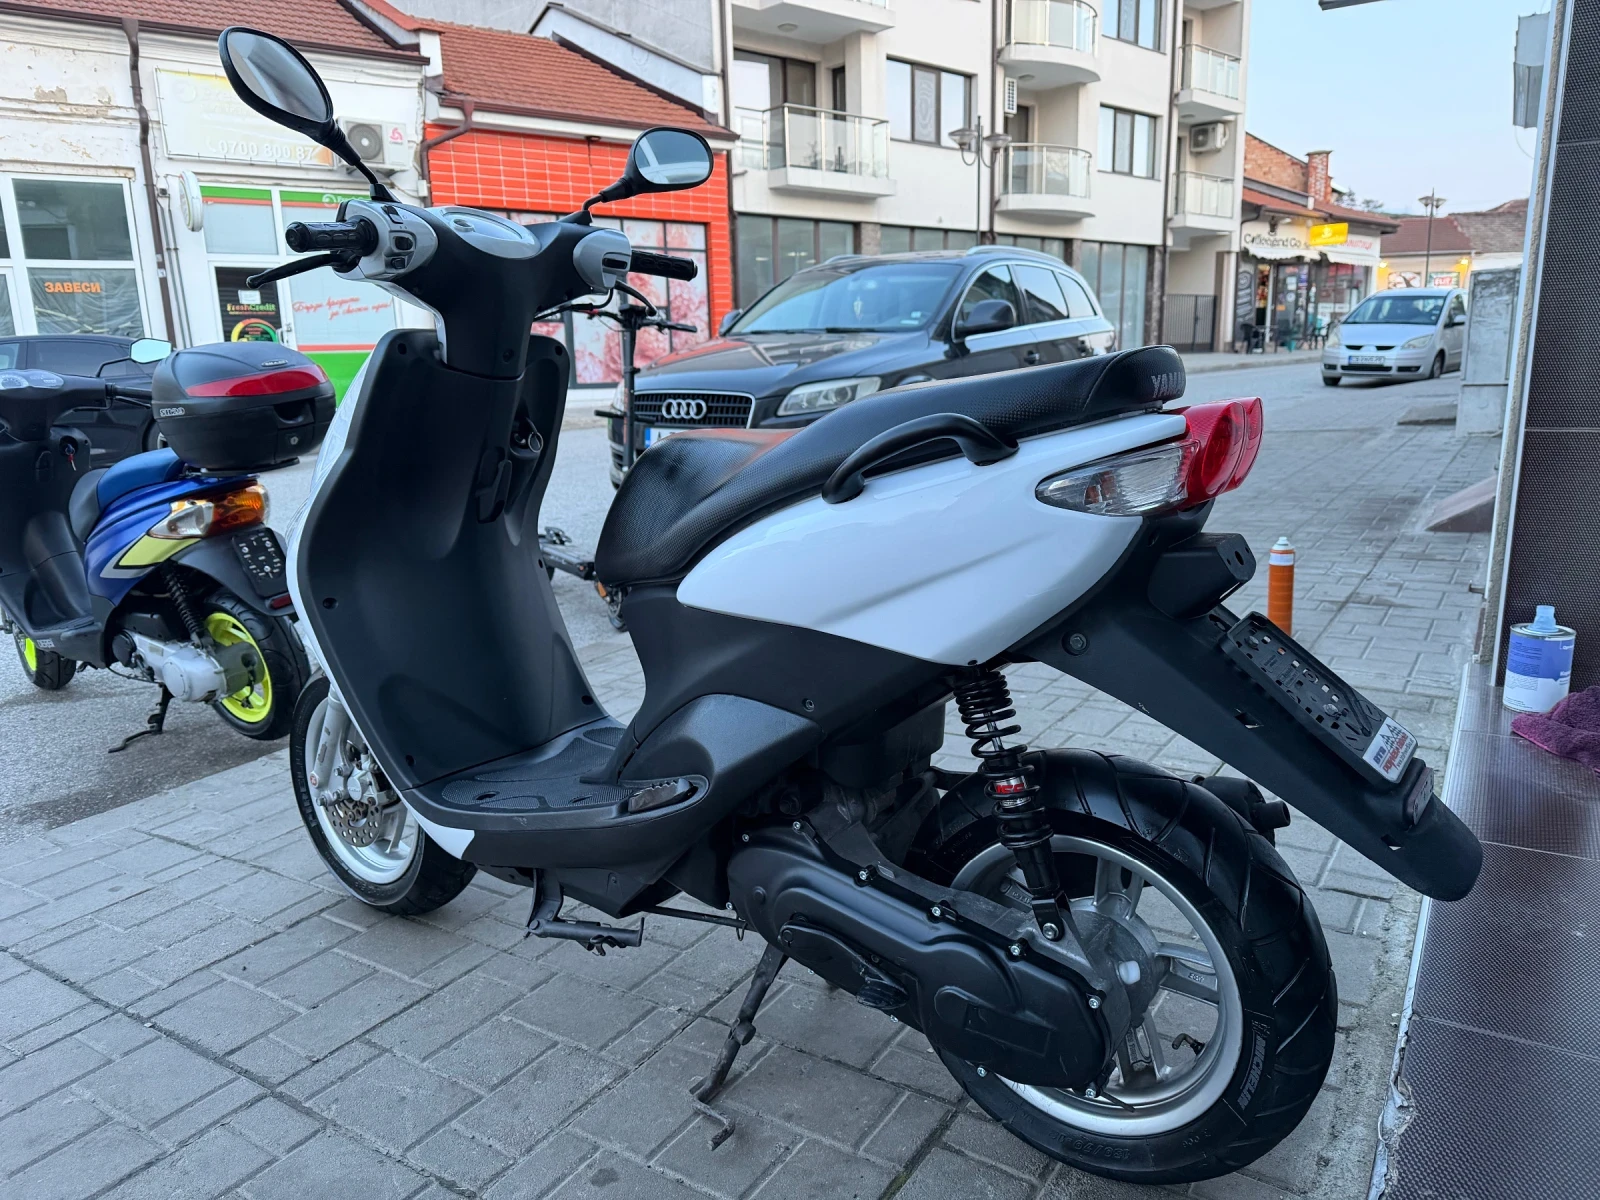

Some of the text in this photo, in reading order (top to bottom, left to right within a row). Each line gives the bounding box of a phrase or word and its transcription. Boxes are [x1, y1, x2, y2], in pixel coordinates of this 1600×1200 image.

[218, 140, 258, 156] 0700
[264, 144, 291, 158] 800
[45, 282, 102, 294] ЗАВЕСИ
[1237, 1033, 1267, 1111] MICHELIN
